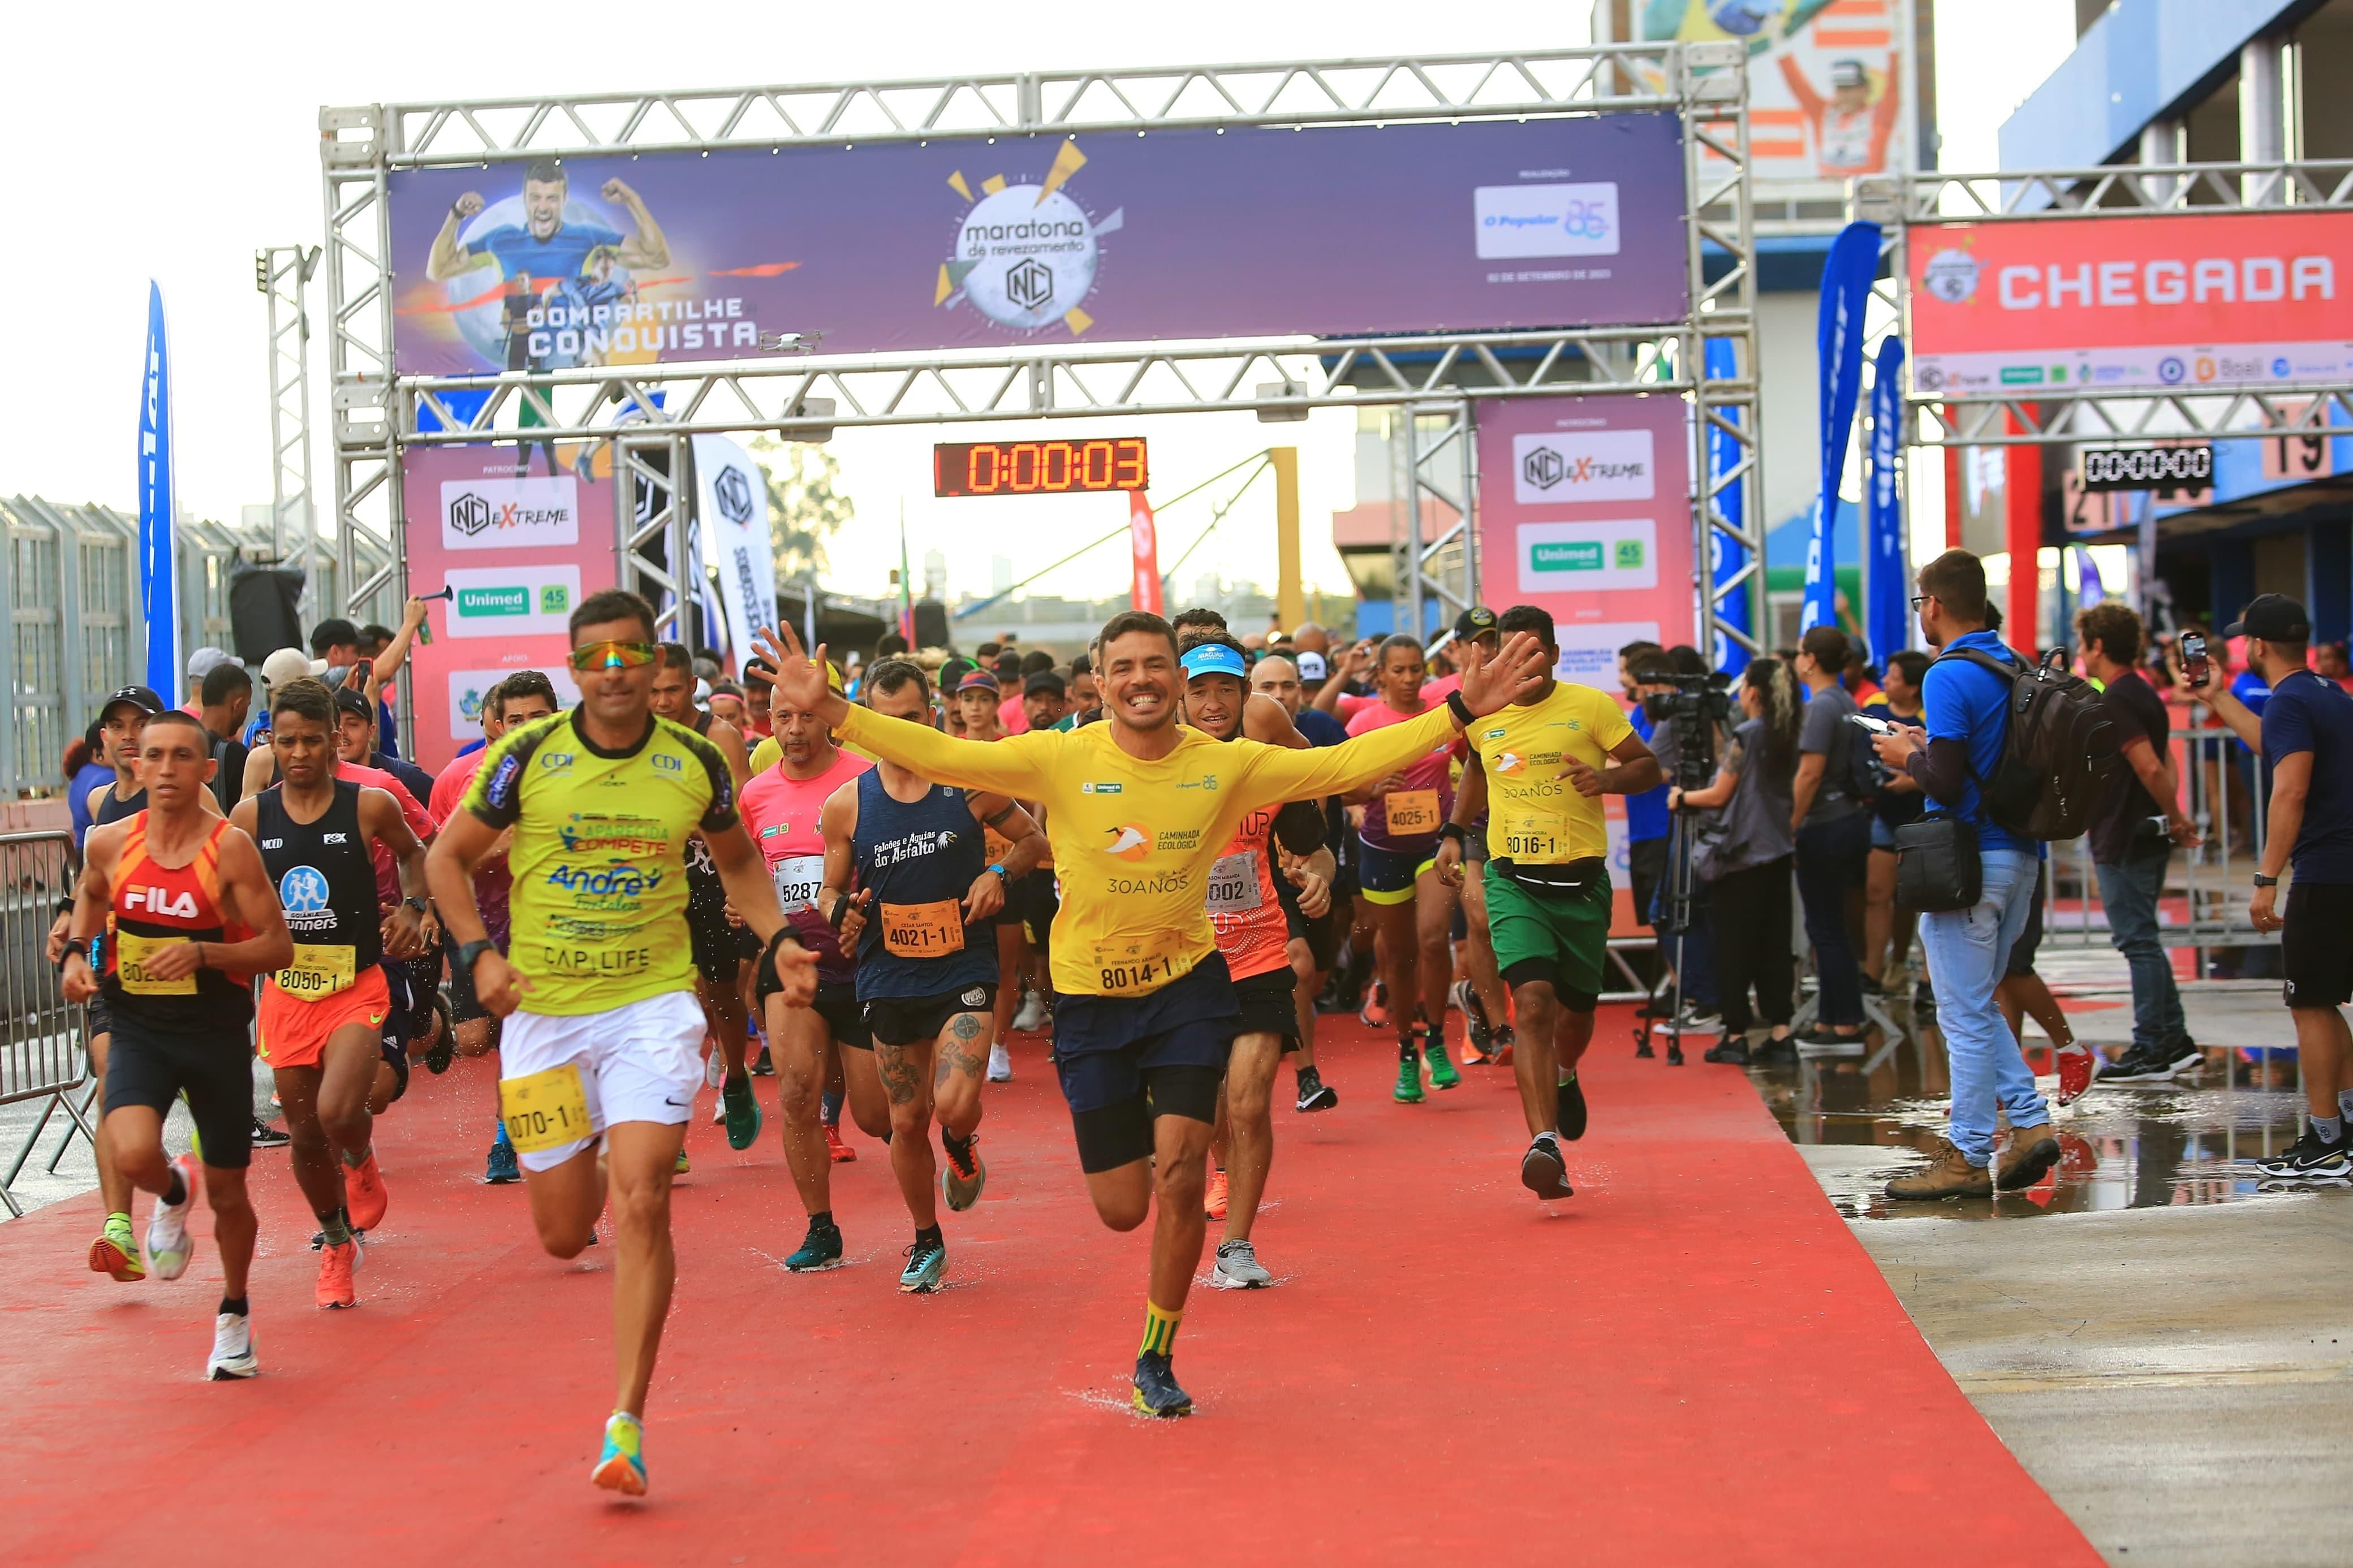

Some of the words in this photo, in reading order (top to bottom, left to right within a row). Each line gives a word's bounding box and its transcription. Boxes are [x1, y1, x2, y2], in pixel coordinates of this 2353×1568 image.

[966, 219, 1083, 241] maratona
[968, 245, 985, 257] de
[992, 241, 1084, 255] revezamento
[1998, 256, 2334, 310] CHEGADA
[527, 297, 742, 327] COMPARTILHE
[528, 321, 757, 357] CONQUISTA
[968, 439, 1146, 493] 0:00:03
[2086, 448, 2211, 482] 00:00:00
[1537, 547, 1597, 561] Unimed
[1619, 546, 1639, 557] 45
[465, 593, 523, 607] Unimed
[545, 590, 564, 602] 45
[652, 754, 681, 771] CDI
[1529, 751, 1562, 760] CAMINHADA
[1391, 810, 1434, 826] 4025-1
[324, 832, 347, 844] FOX
[586, 825, 668, 839] APARECIDA
[1160, 830, 1200, 841] CAMINHADA
[573, 838, 667, 855] COMPETE
[874, 839, 900, 854] Falcões
[875, 854, 887, 868] do
[891, 841, 934, 864] Asfalto
[1158, 840, 1197, 850] ECOLÓGICA
[124, 884, 199, 918] FILA
[783, 882, 822, 902] 5287
[1205, 881, 1244, 901] 002
[285, 917, 338, 930] unners
[890, 926, 946, 946] 4021-1
[602, 948, 649, 969] LIFE
[281, 969, 337, 992] 8050-1
[1101, 956, 1172, 990] 8014-1
